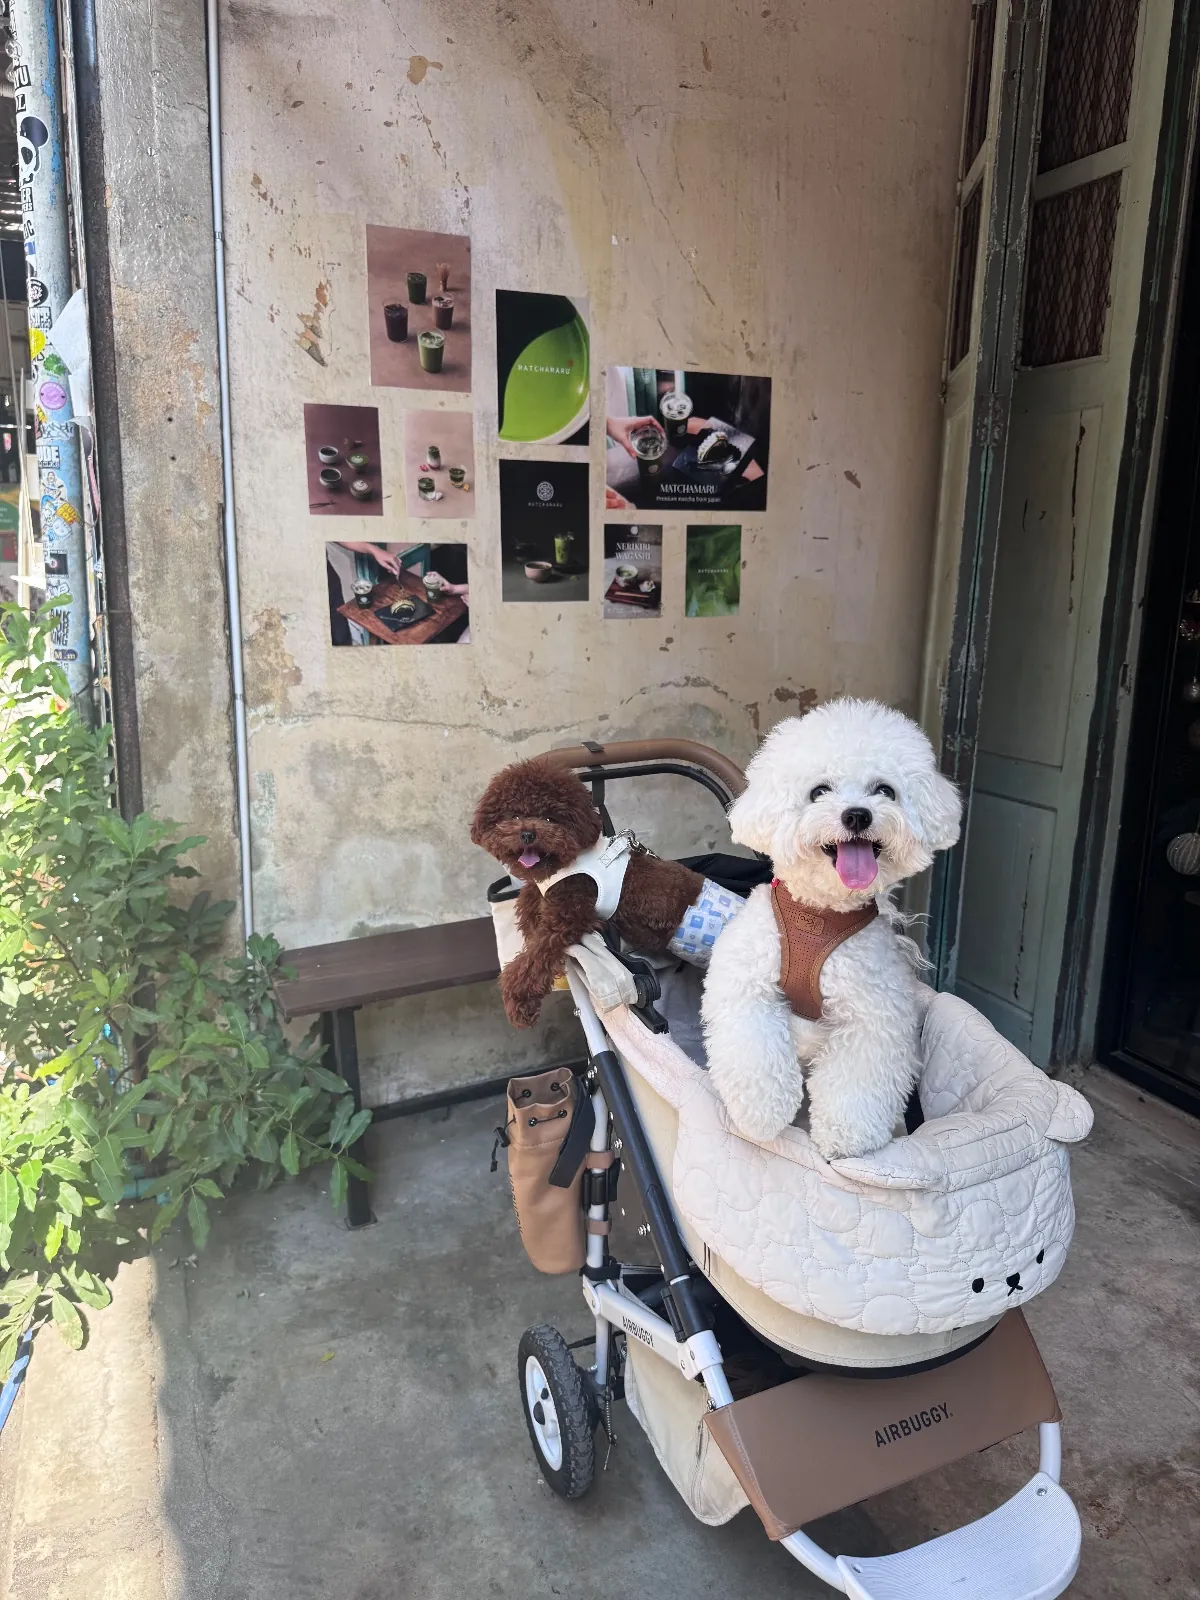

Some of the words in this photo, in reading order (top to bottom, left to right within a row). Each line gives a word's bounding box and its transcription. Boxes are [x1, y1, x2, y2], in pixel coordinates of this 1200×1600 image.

[660, 483, 718, 495] MATCHAMARU
[616, 542, 651, 551] NERIKIRI
[615, 552, 651, 560] WAGASHI
